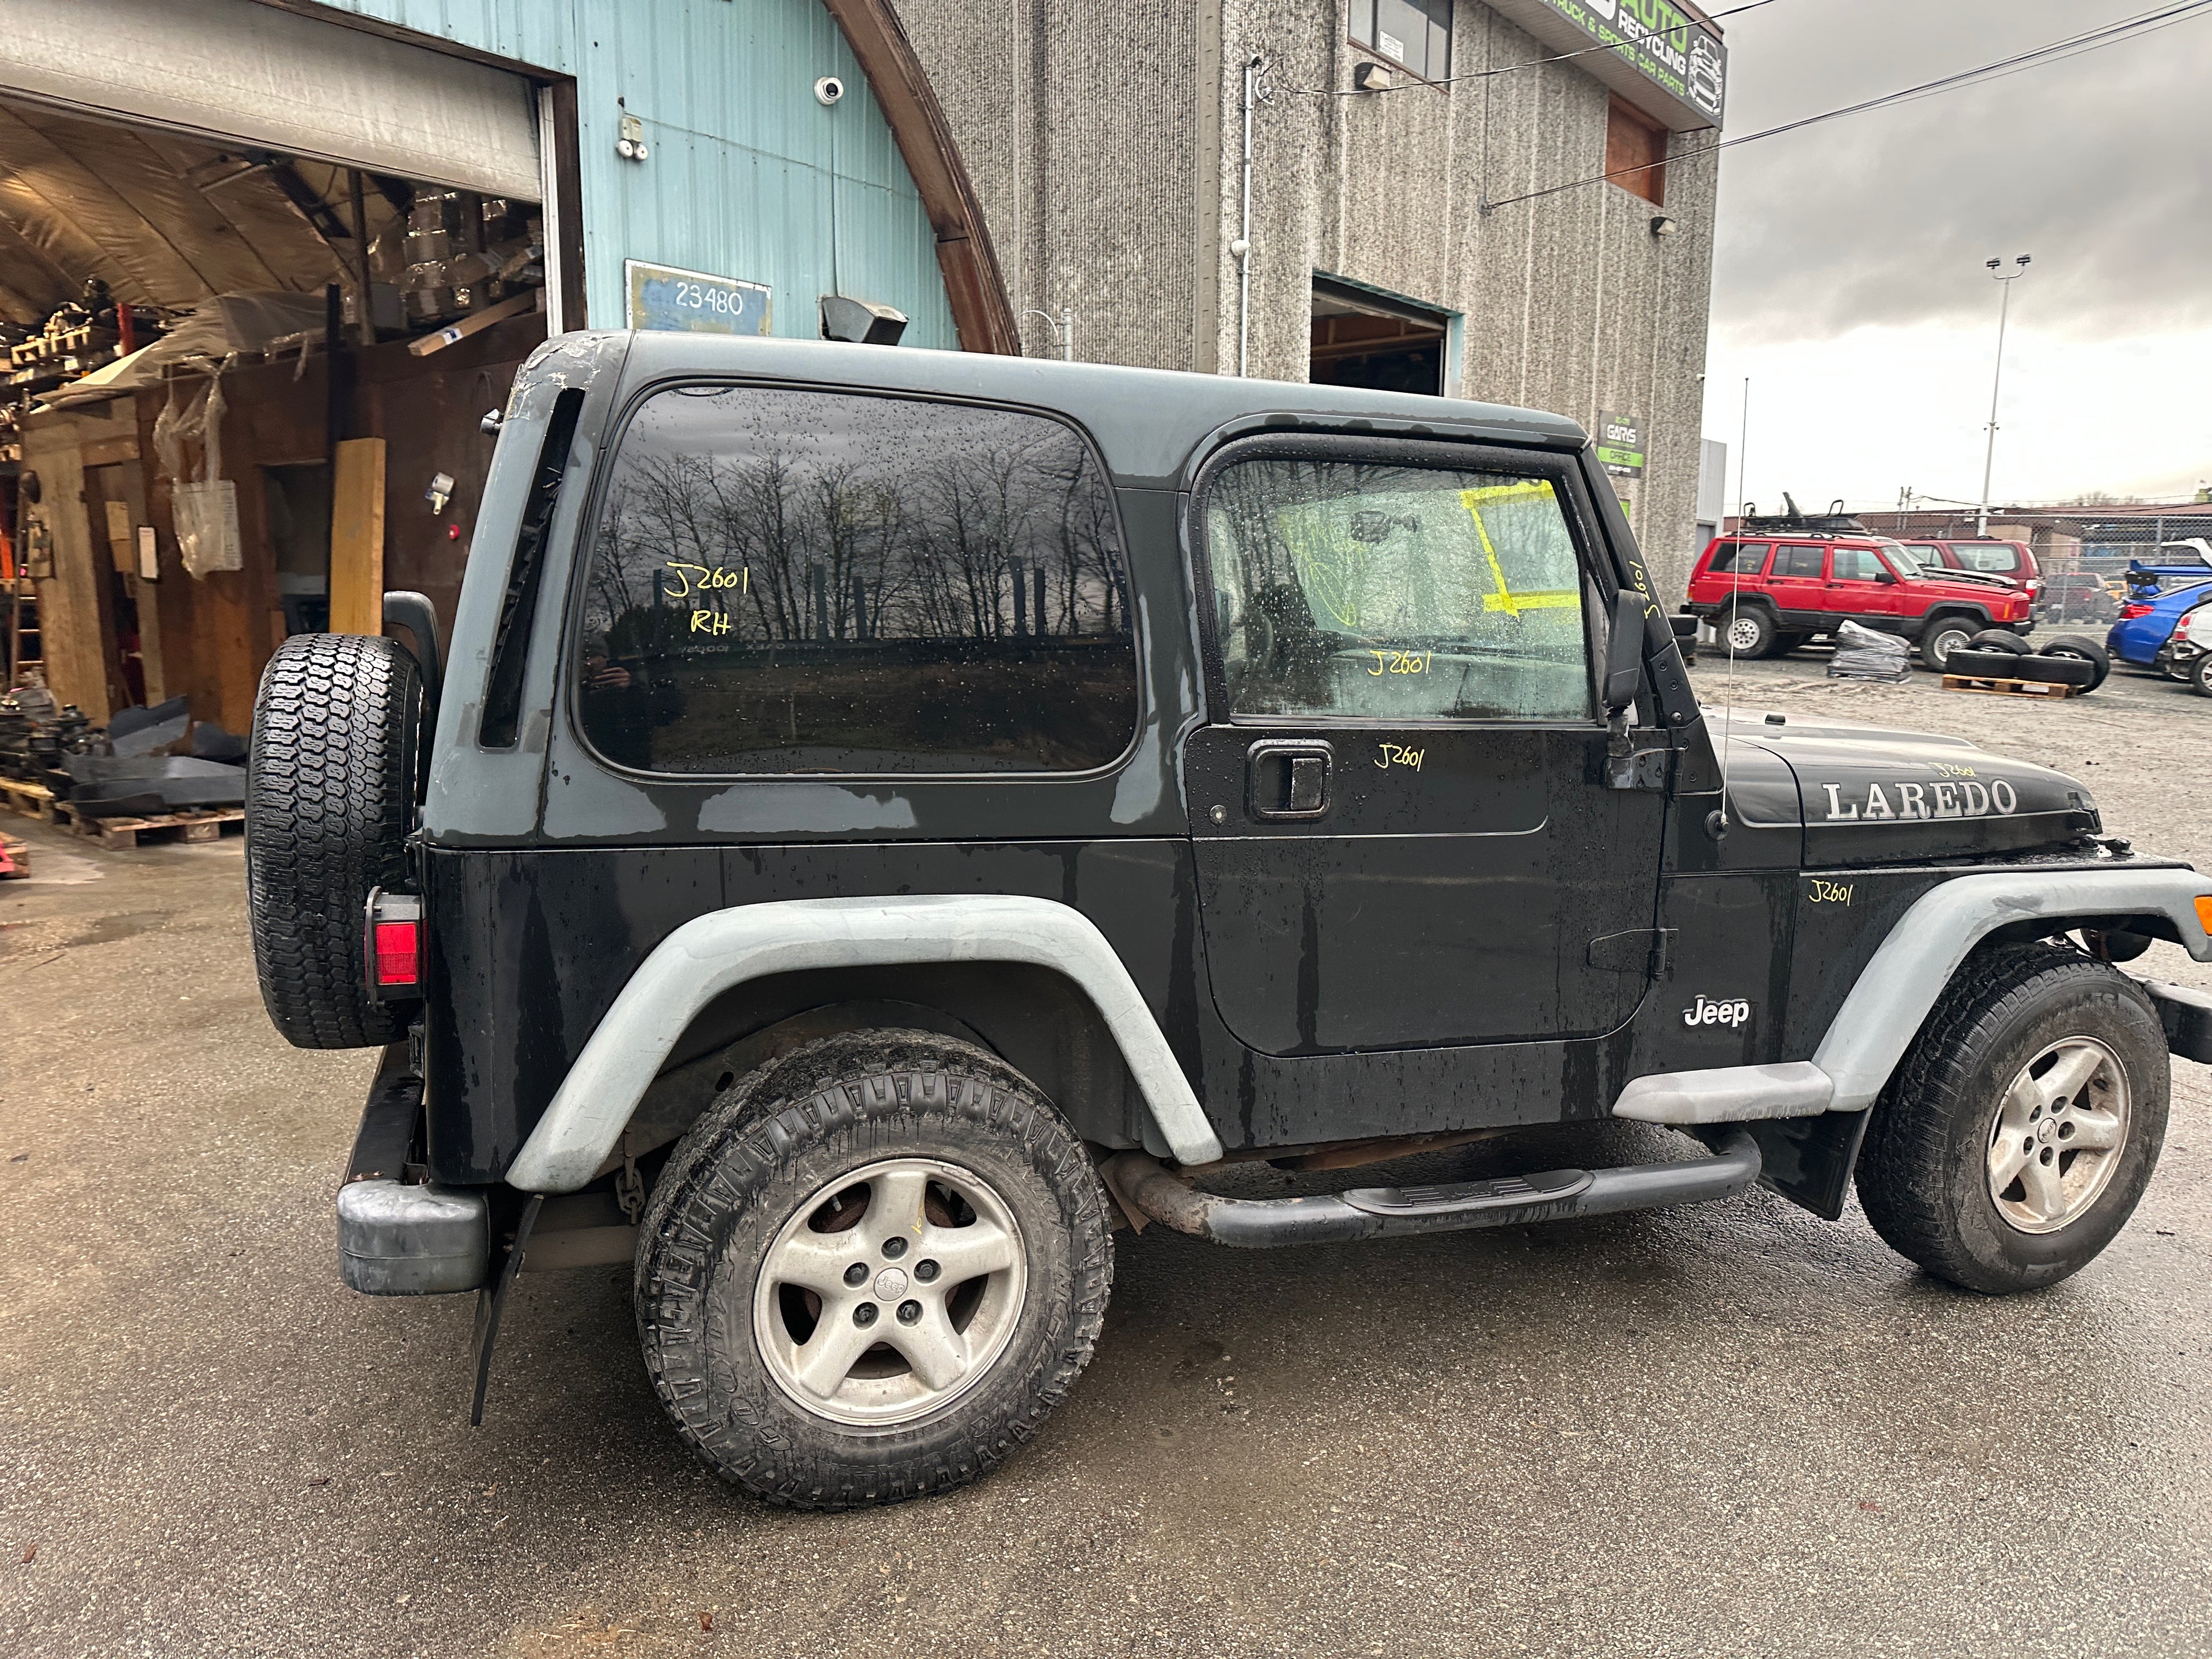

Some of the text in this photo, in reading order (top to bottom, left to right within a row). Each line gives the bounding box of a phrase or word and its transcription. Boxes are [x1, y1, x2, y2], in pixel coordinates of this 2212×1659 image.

[1588, 16, 1596, 33] &
[1598, 24, 1635, 61] SPORTS
[1637, 52, 1657, 76] CAR
[1657, 67, 1685, 96] PARTS
[1618, 9, 1686, 75] RECYCLING
[676, 282, 743, 315] 23480
[664, 561, 748, 597] J2601
[691, 609, 732, 636] RH
[1367, 650, 1431, 676] J2601
[1374, 744, 1425, 772] J2601
[1928, 762, 1976, 778] J2601
[1822, 779, 2017, 821] LAREDO
[1809, 879, 1853, 907] J2601
[1684, 998, 1749, 1028] Jeep
[877, 1275, 906, 1294] Jeep
